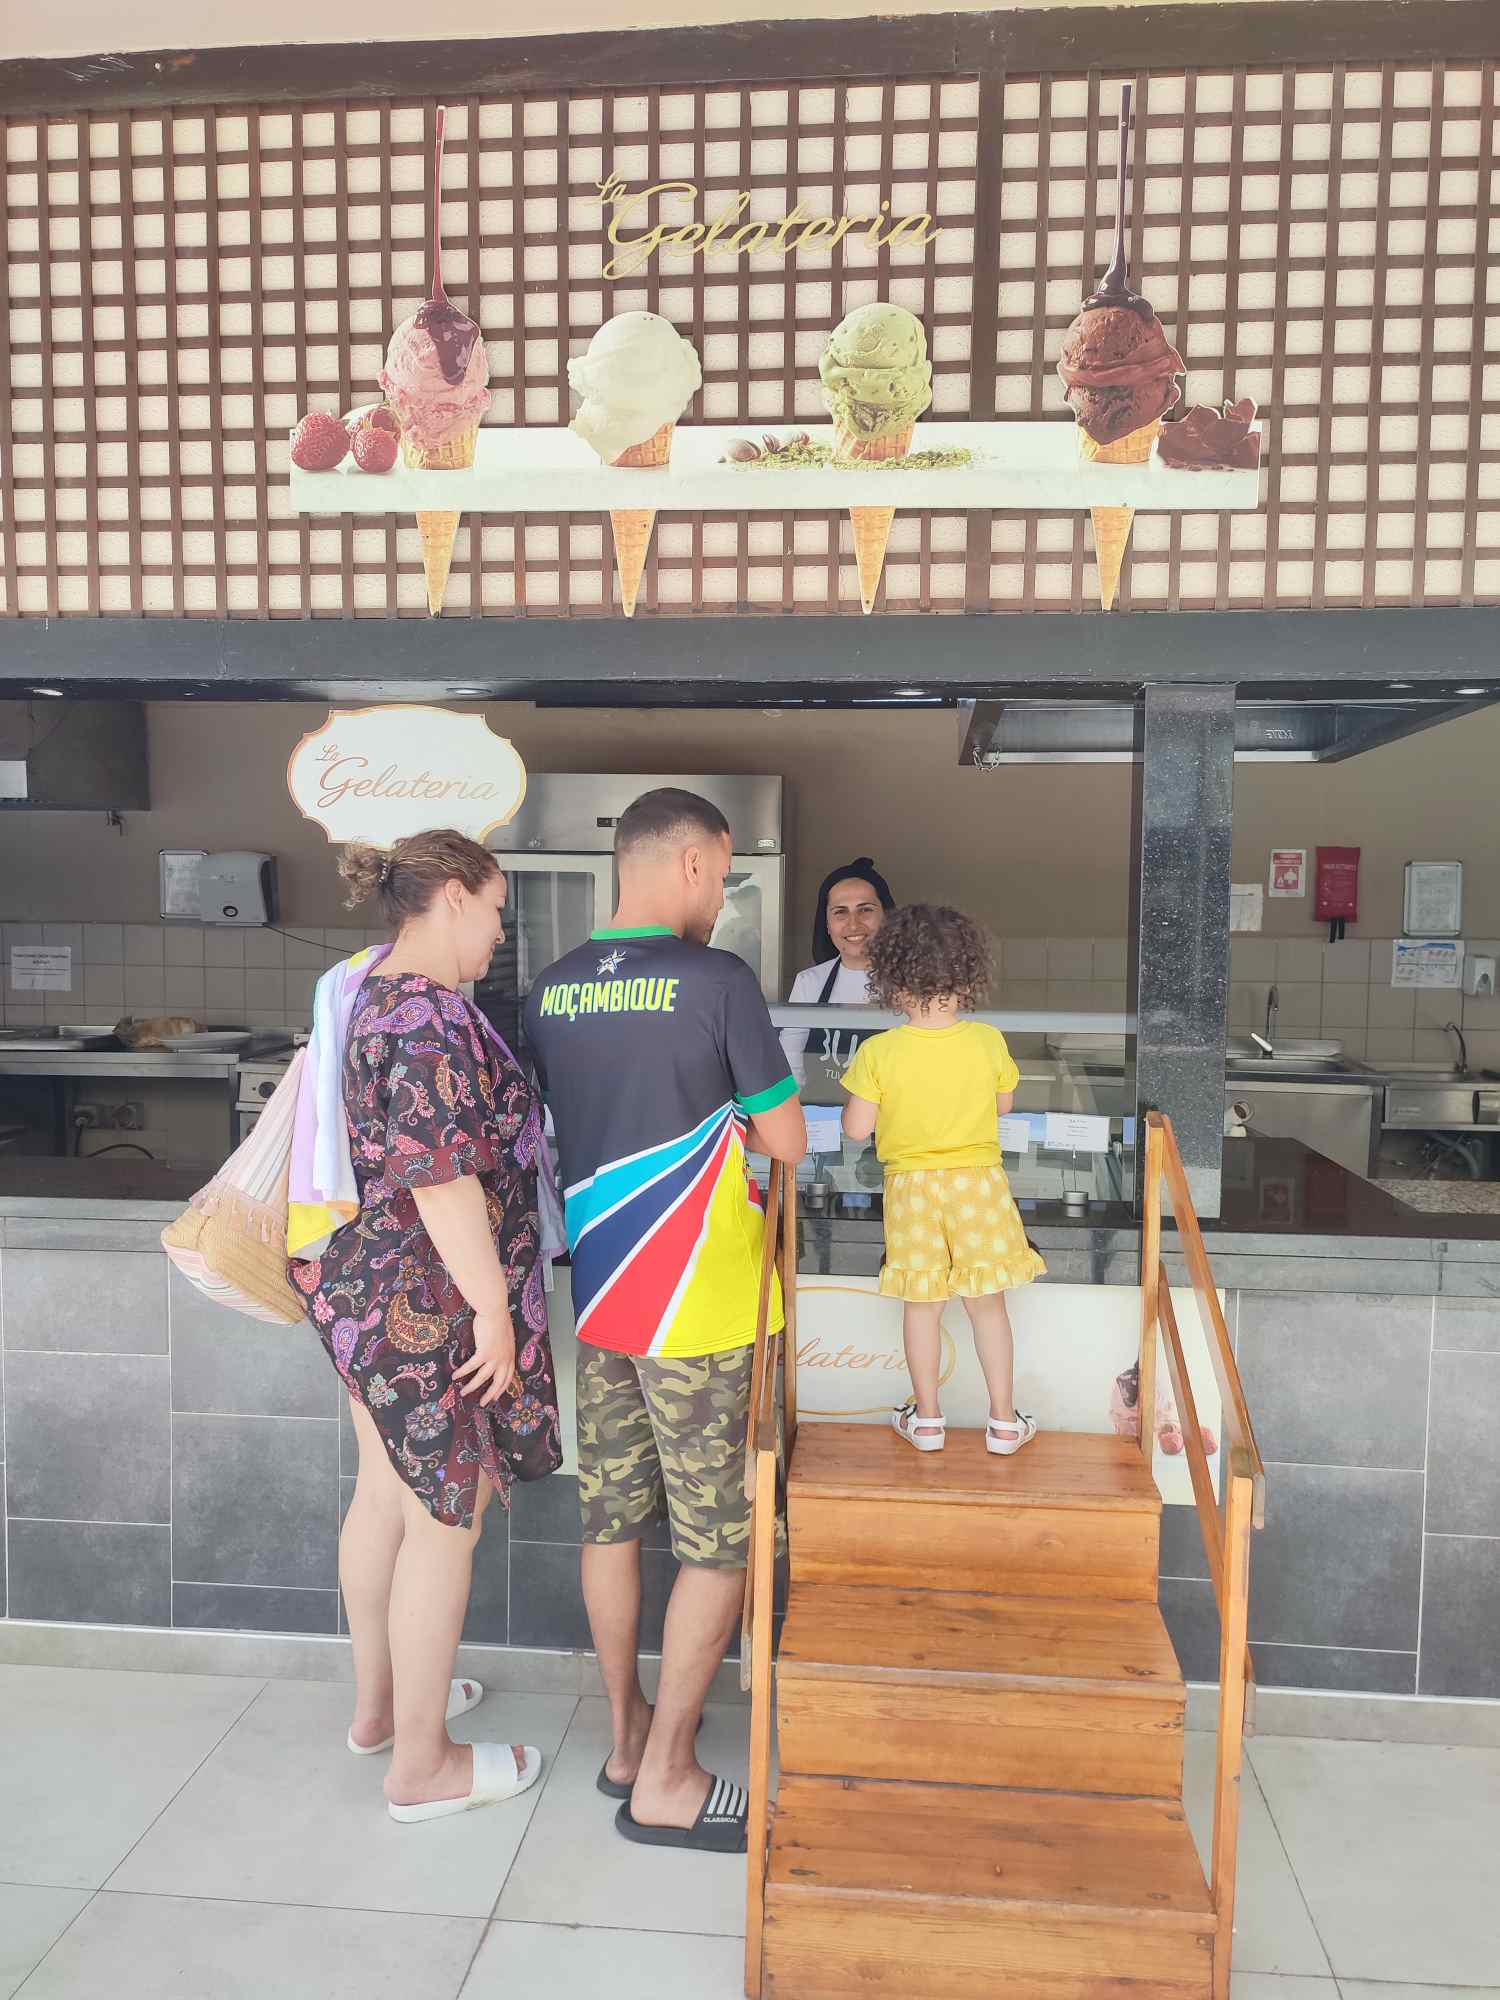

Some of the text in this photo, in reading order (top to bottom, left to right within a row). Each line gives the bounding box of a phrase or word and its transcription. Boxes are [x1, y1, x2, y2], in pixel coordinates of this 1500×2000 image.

[602, 182, 943, 280] Gelateria
[315, 743, 339, 762] La
[316, 756, 499, 808] Gelateria
[540, 977, 680, 1022] MOÇAMBIQUE
